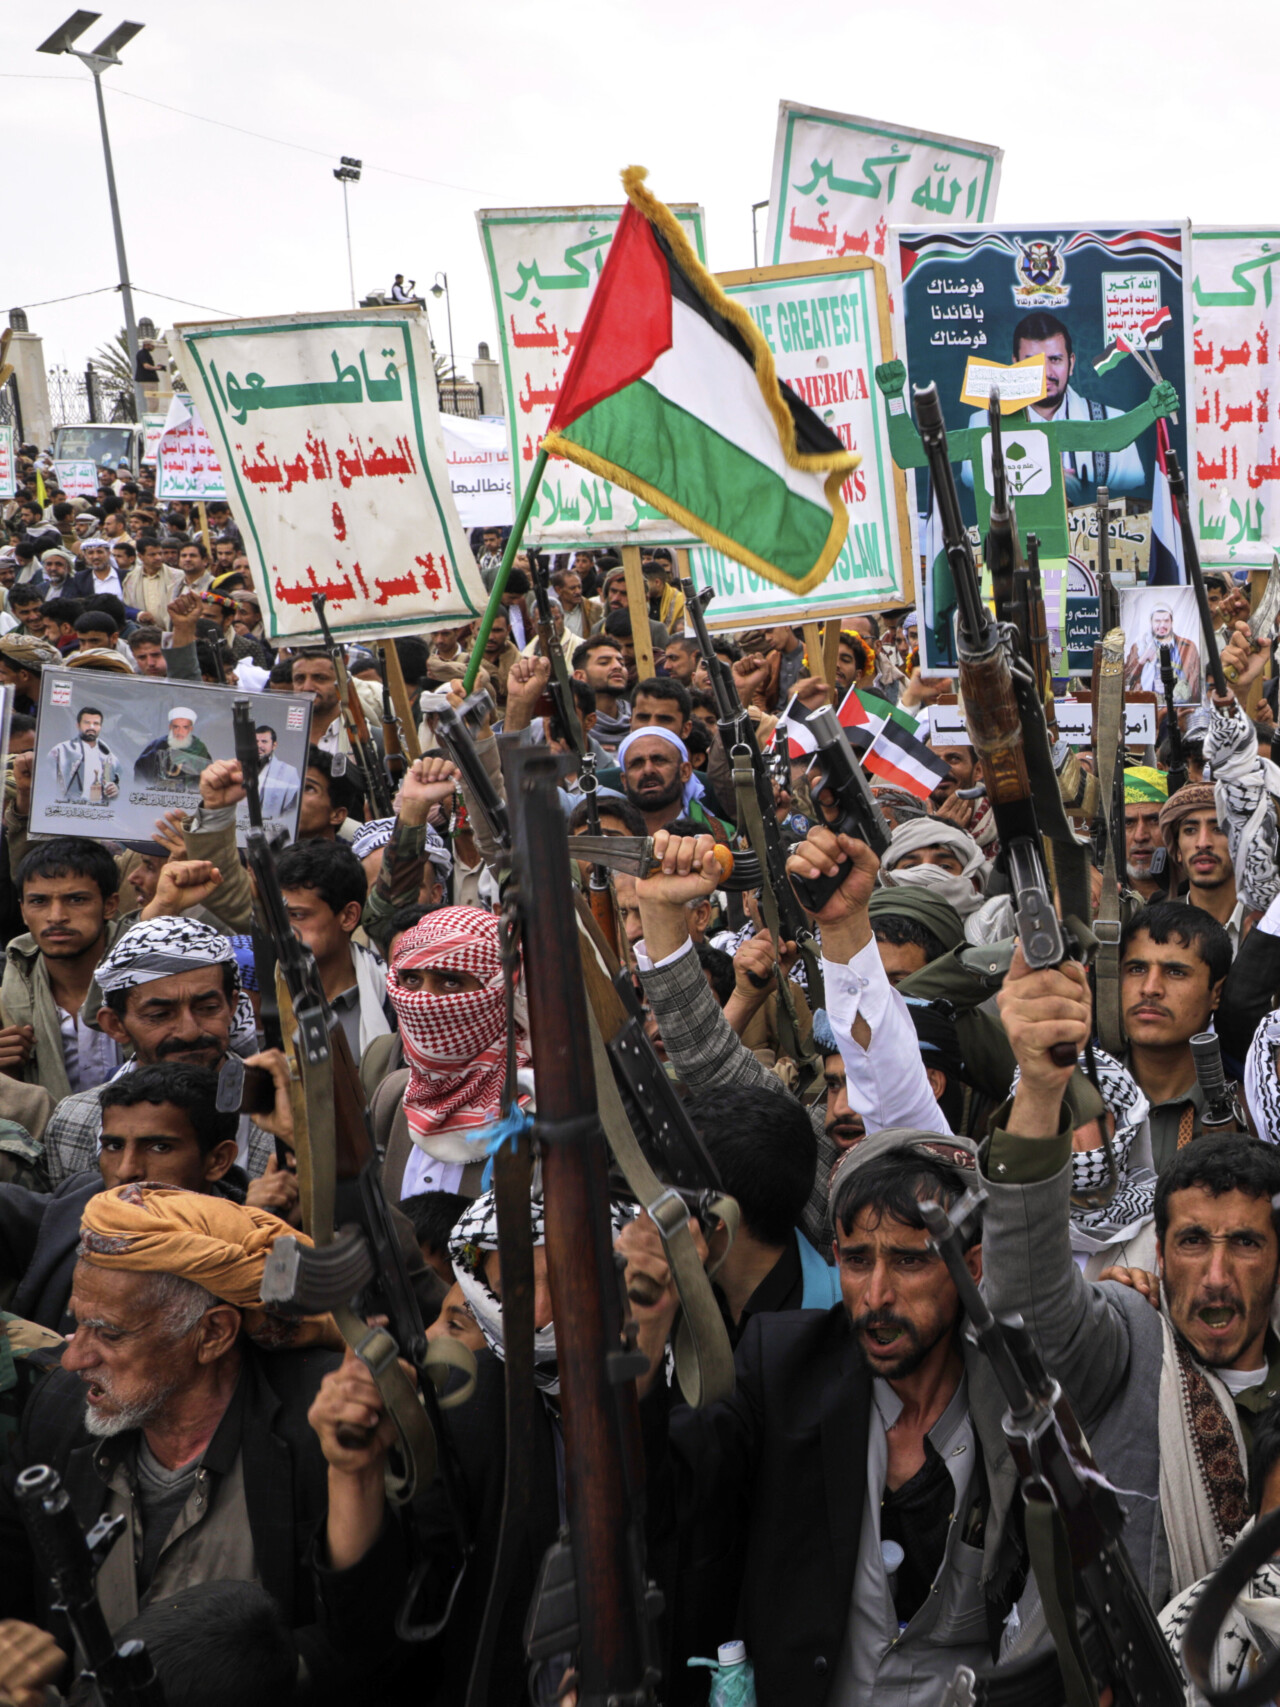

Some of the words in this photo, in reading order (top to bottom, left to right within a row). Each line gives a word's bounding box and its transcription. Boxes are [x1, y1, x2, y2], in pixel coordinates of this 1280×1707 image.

[792, 143, 912, 207] أكبر
[911, 162, 979, 220] الله
[926, 277, 985, 299] فوضناك
[510, 312, 583, 356] ريكا
[777, 293, 862, 355] GREATEST
[929, 329, 988, 351] فوضناك
[210, 347, 403, 426] قاطعوا
[236, 429, 333, 494] الأمريكية
[335, 433, 417, 490] البضائع
[332, 501, 348, 542] و
[528, 476, 614, 537] للإسلام
[272, 552, 452, 614] الإسرائيلية
